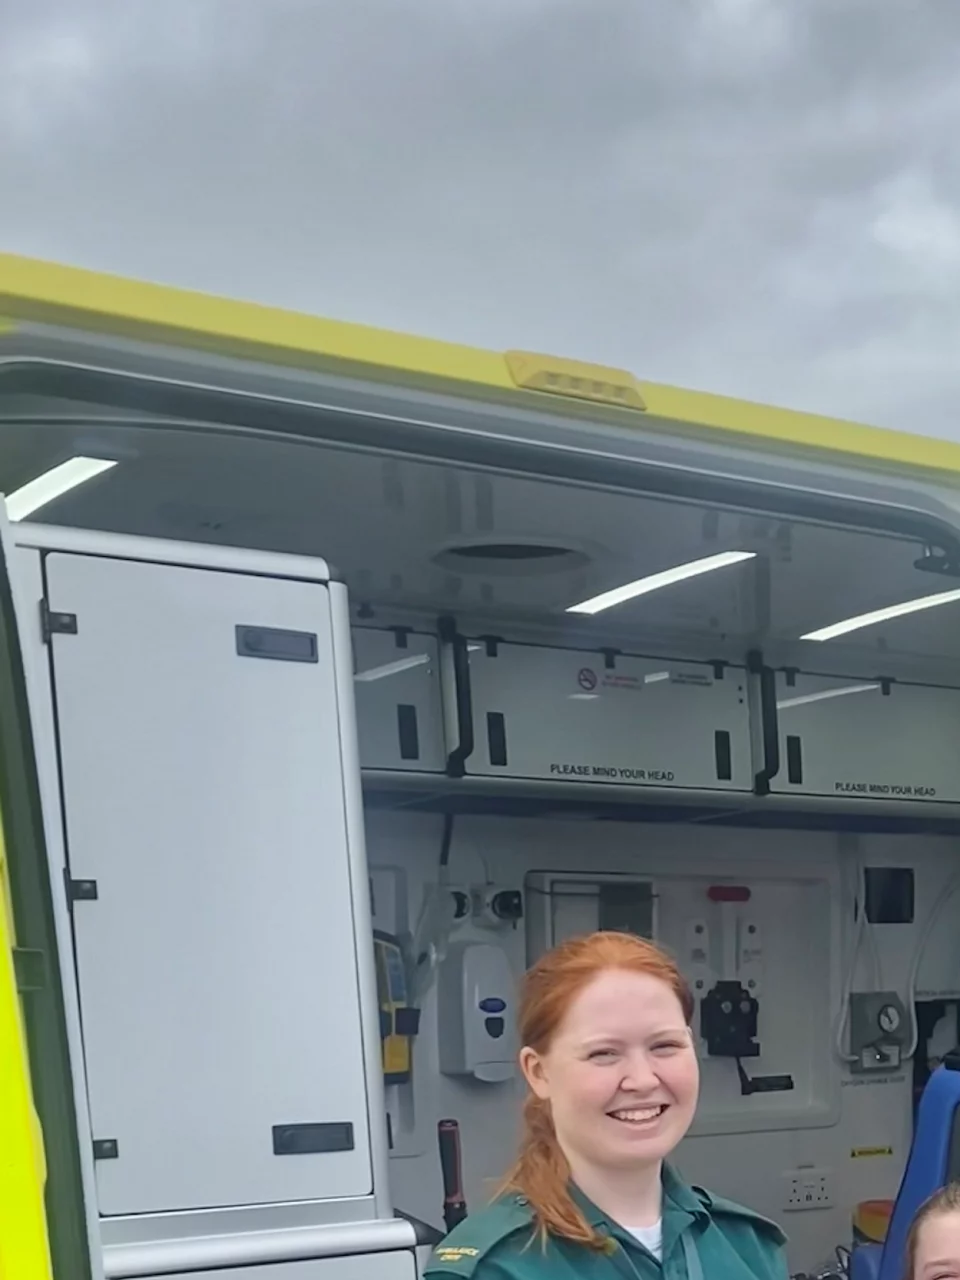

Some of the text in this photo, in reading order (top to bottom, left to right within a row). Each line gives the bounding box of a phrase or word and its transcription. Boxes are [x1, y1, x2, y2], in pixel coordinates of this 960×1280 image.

[550, 764, 674, 781] PLEASE MIND YOUR HEAD
[835, 782, 936, 796] PLEASE MIND YOUR HEAD
